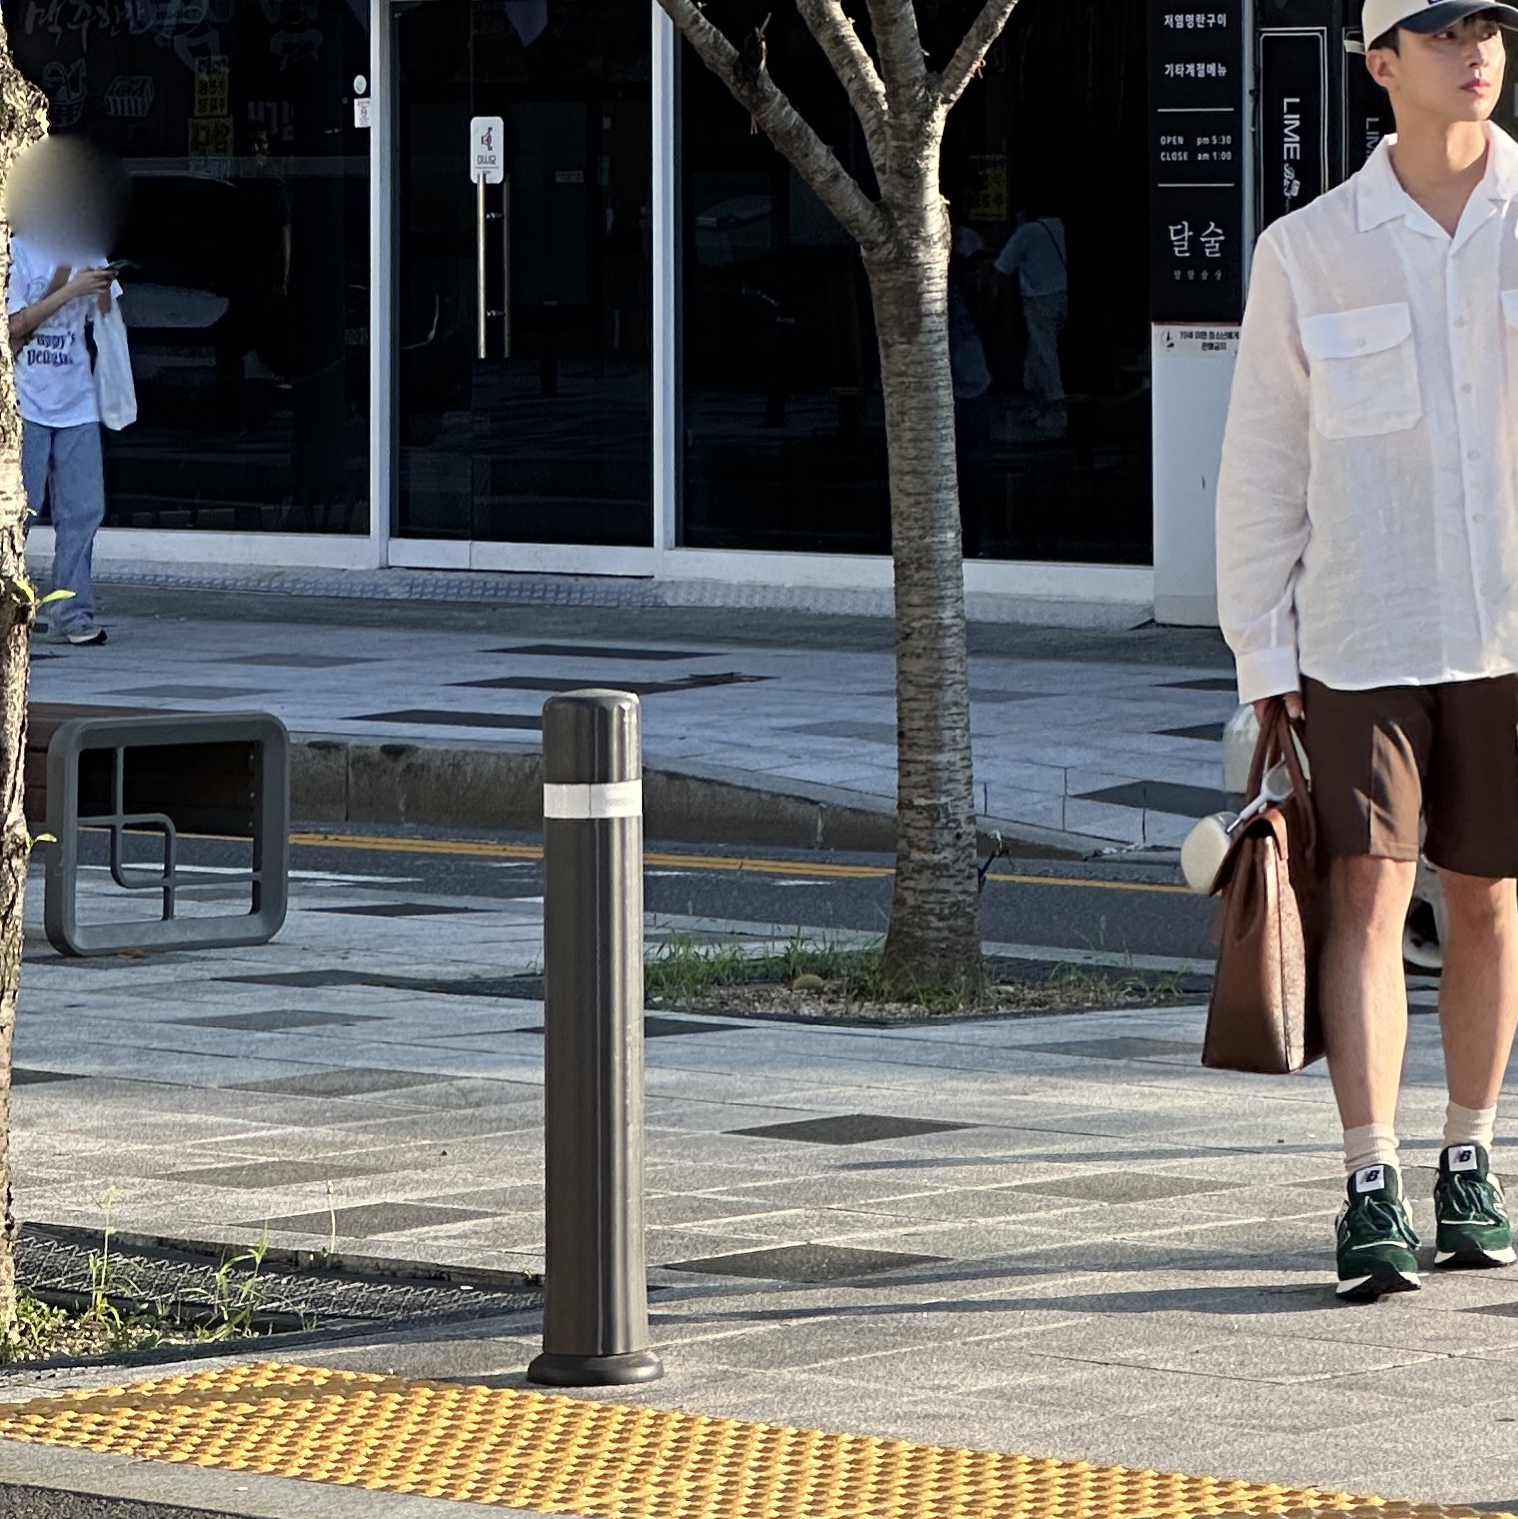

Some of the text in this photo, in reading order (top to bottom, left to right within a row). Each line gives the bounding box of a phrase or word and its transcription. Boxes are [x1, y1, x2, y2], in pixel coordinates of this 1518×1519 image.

[1164, 13, 1228, 29] 저염명란구이
[1284, 97, 1301, 161] LIME
[1160, 135, 1184, 145] OPEN
[1365, 117, 1380, 162] LIM
[1160, 151, 1189, 161] CLOSE
